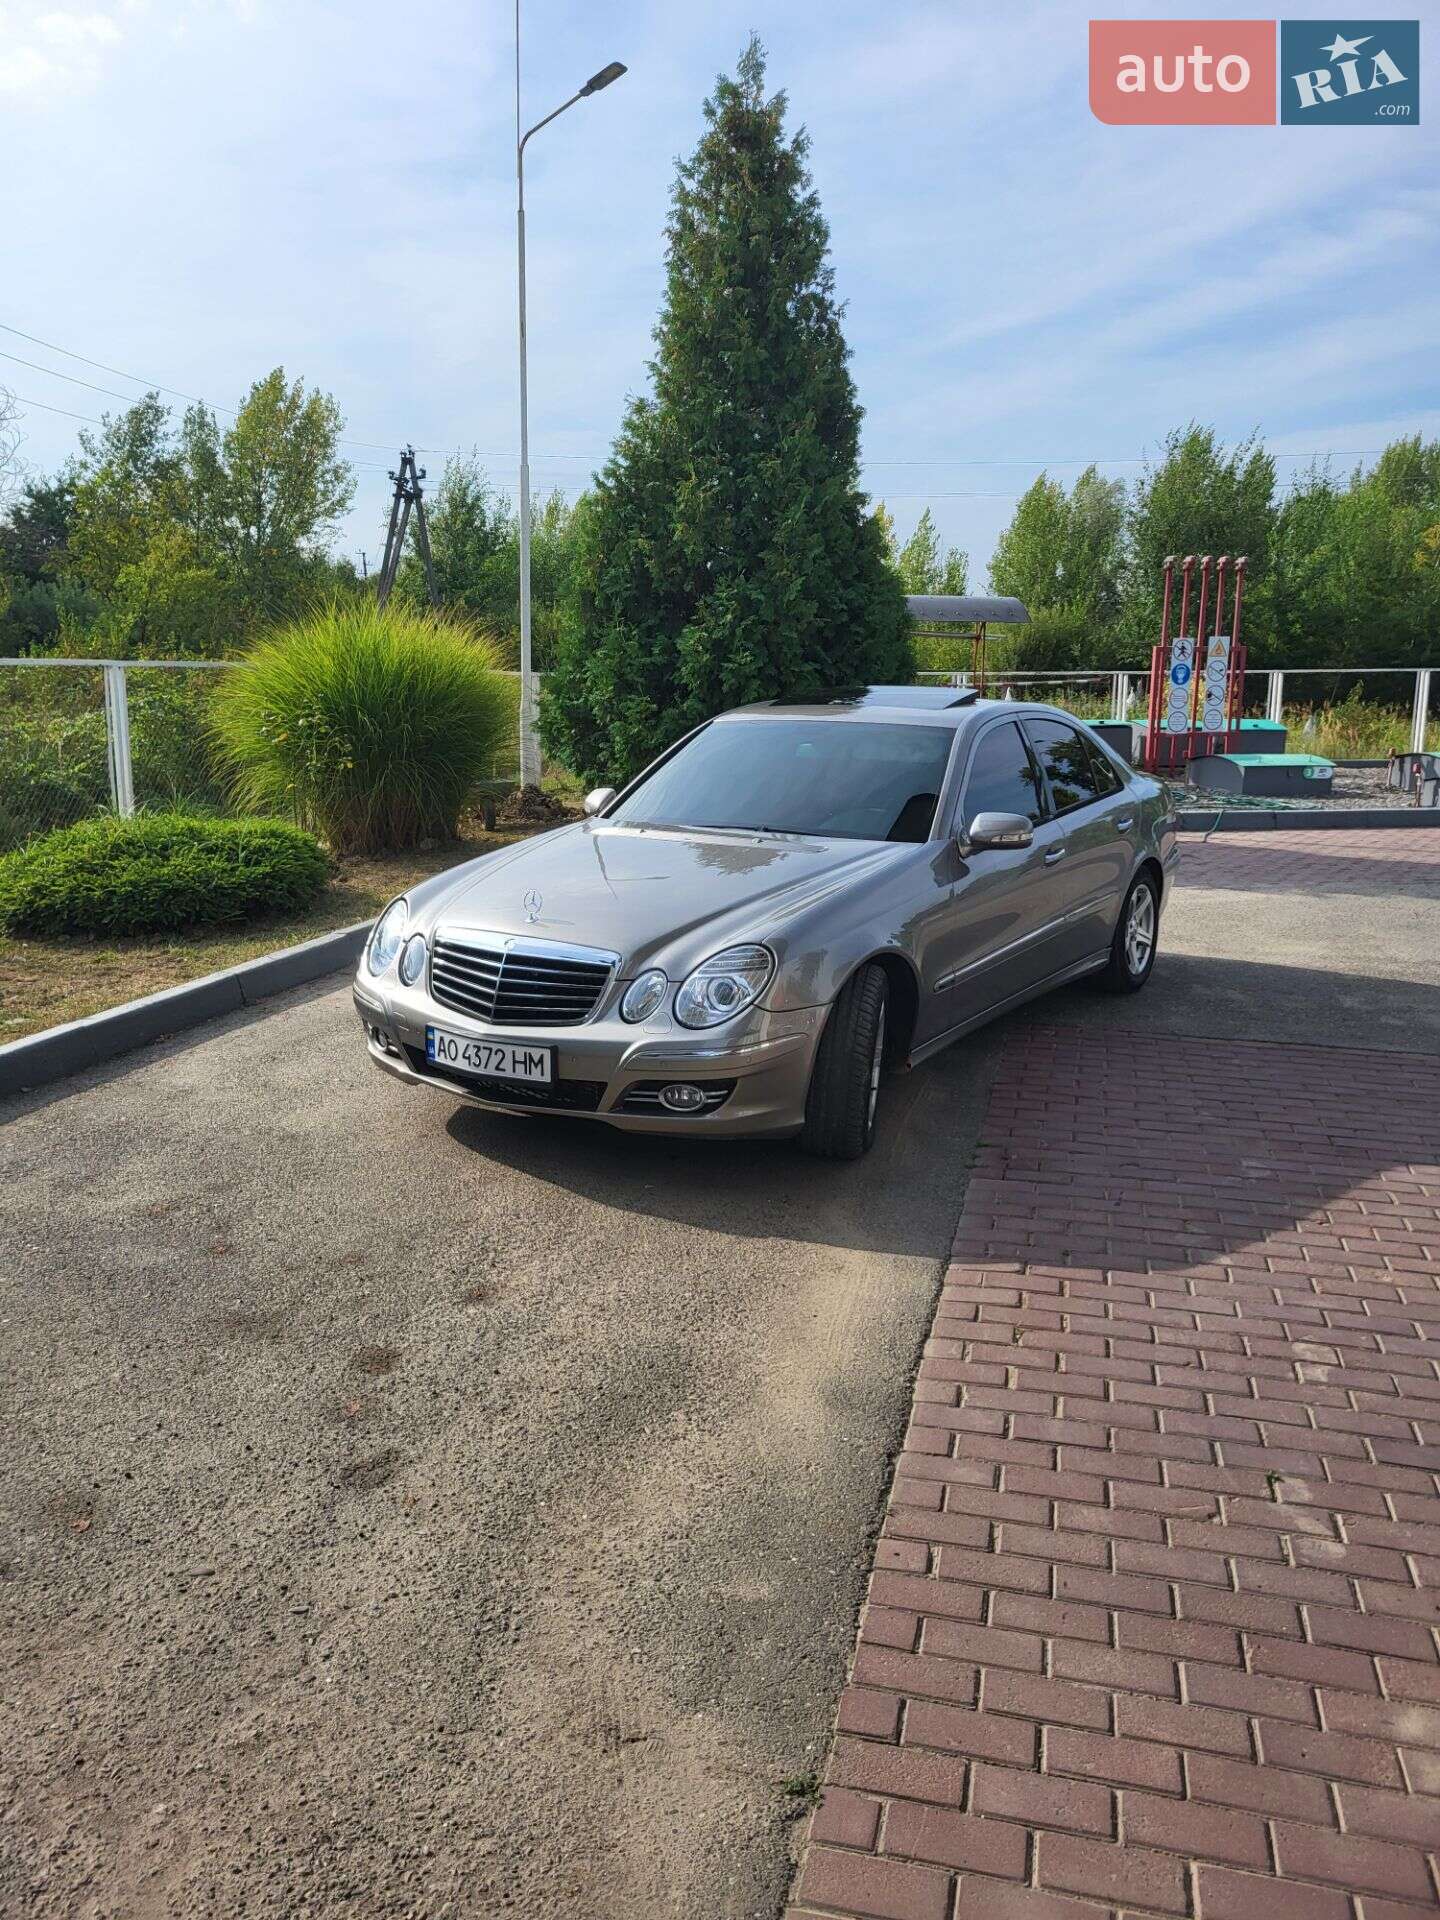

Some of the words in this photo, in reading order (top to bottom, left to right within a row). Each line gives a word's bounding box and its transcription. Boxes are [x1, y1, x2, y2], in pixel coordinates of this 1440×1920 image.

[437, 1036, 459, 1061] AO
[462, 1043, 506, 1072] 4372
[512, 1050, 545, 1077] HM
